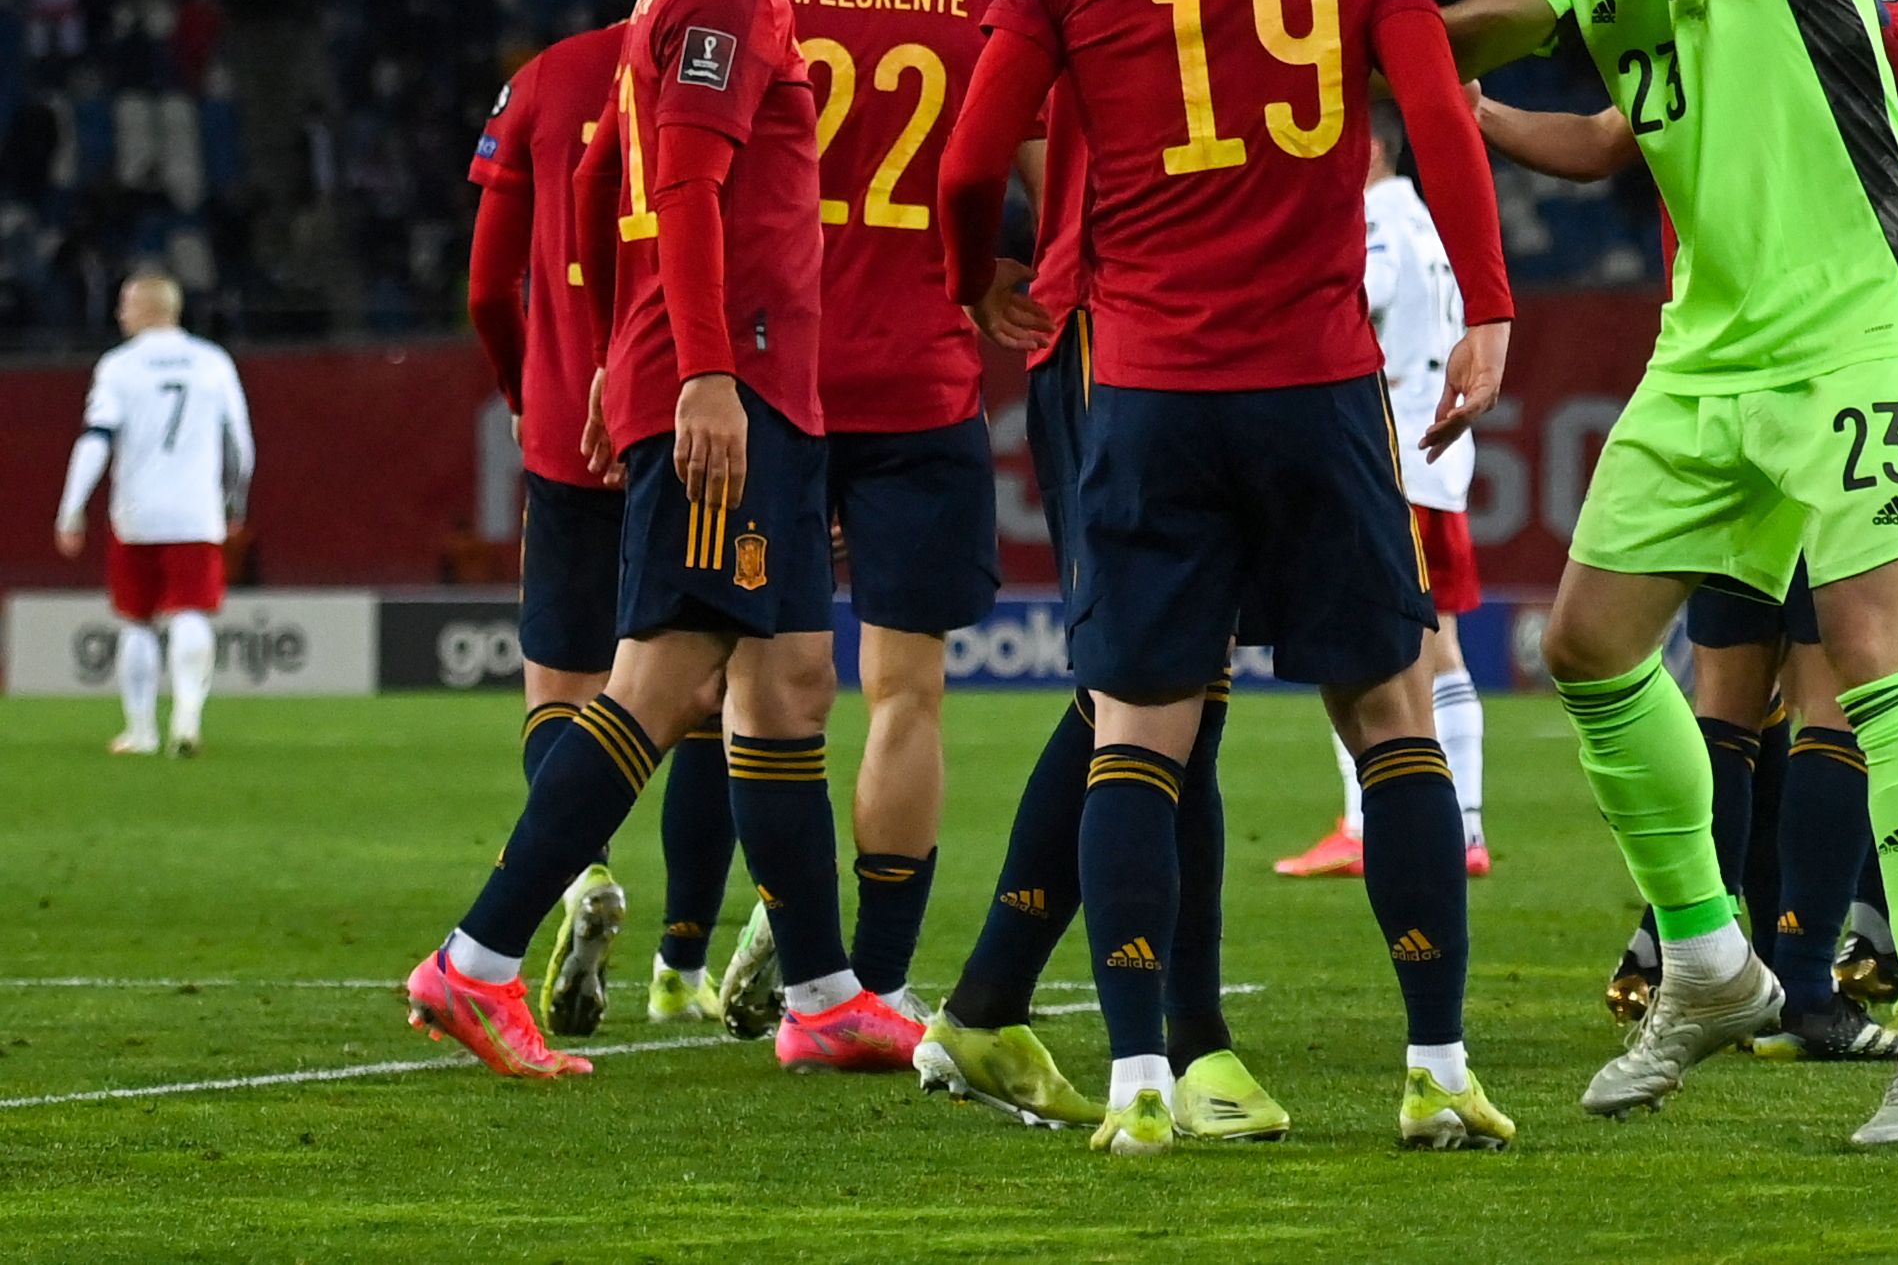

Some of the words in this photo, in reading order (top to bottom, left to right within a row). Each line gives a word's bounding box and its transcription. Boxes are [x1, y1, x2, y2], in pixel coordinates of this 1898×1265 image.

[1618, 40, 1687, 135] 23
[792, 37, 947, 230] 22
[159, 382, 186, 453] 7
[1106, 956, 1163, 971] adidas
